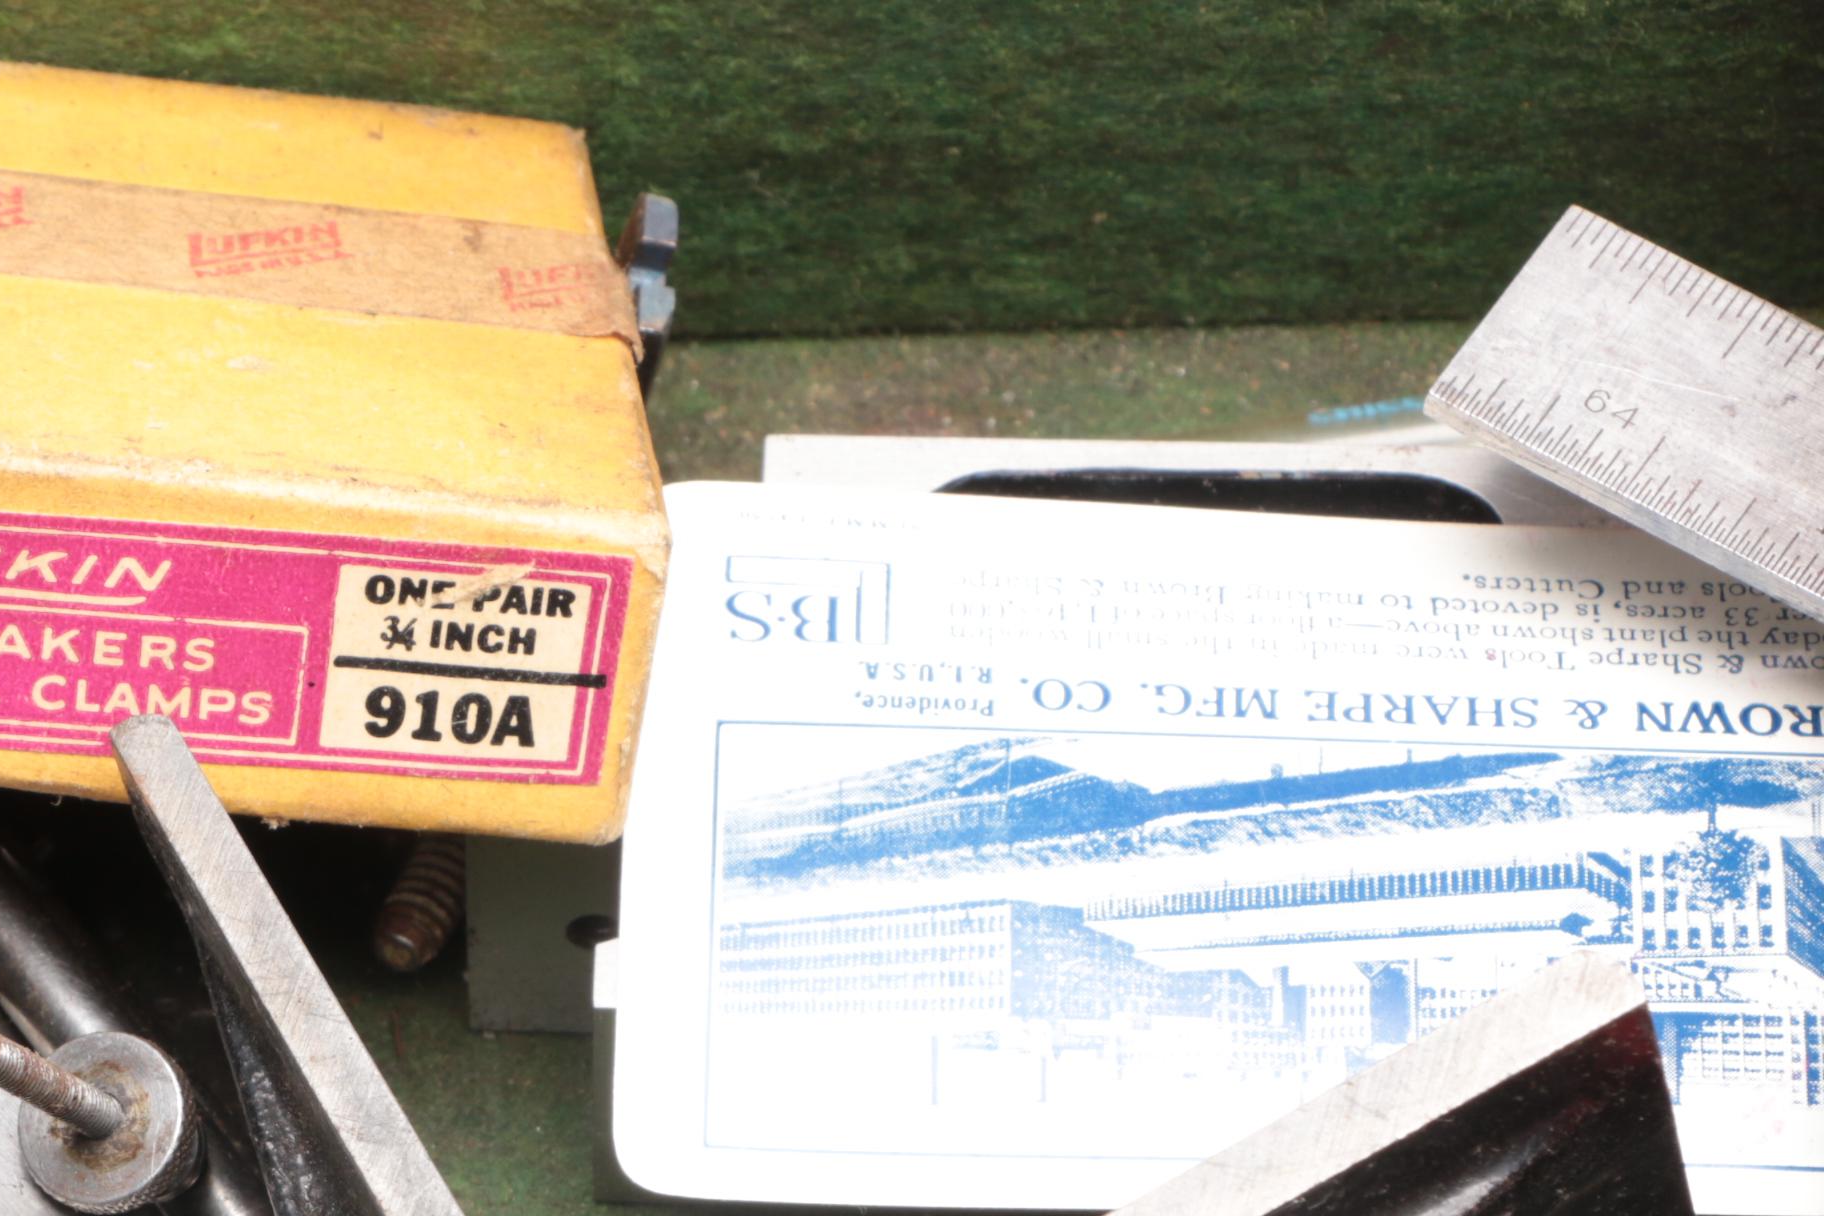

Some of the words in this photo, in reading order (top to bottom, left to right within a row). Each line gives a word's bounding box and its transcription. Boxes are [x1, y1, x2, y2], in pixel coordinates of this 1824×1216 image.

[187, 221, 342, 266] LUFKIN
[1584, 388, 1638, 430] 64
[365, 574, 456, 609] ONE
[472, 584, 576, 619] PAIR
[1462, 574, 1605, 600] Cutters.
[1621, 580, 1686, 600] and
[1701, 582, 1774, 603] ools
[1380, 594, 1412, 611] to
[1430, 597, 1559, 621] devoted
[1575, 603, 1601, 622] is
[1613, 601, 1705, 621] acres,
[1723, 608, 1759, 626] 33
[430, 620, 536, 655] INCH
[1492, 623, 1593, 645] shown
[1601, 626, 1687, 648] plant
[1697, 630, 1749, 649] the
[1760, 628, 1824, 651] day
[1394, 644, 1469, 661] were
[1485, 648, 1575, 671] Tools
[1589, 649, 1702, 675] Sharpe
[1717, 654, 1744, 674] &
[32, 674, 273, 725] CLAMPS
[853, 690, 995, 717] Providence,
[1019, 677, 1113, 713] CO.
[1139, 682, 1280, 720] MFG.
[364, 684, 536, 748] 910A
[1304, 690, 1539, 728] SHARPE
[1565, 699, 1609, 730] &
